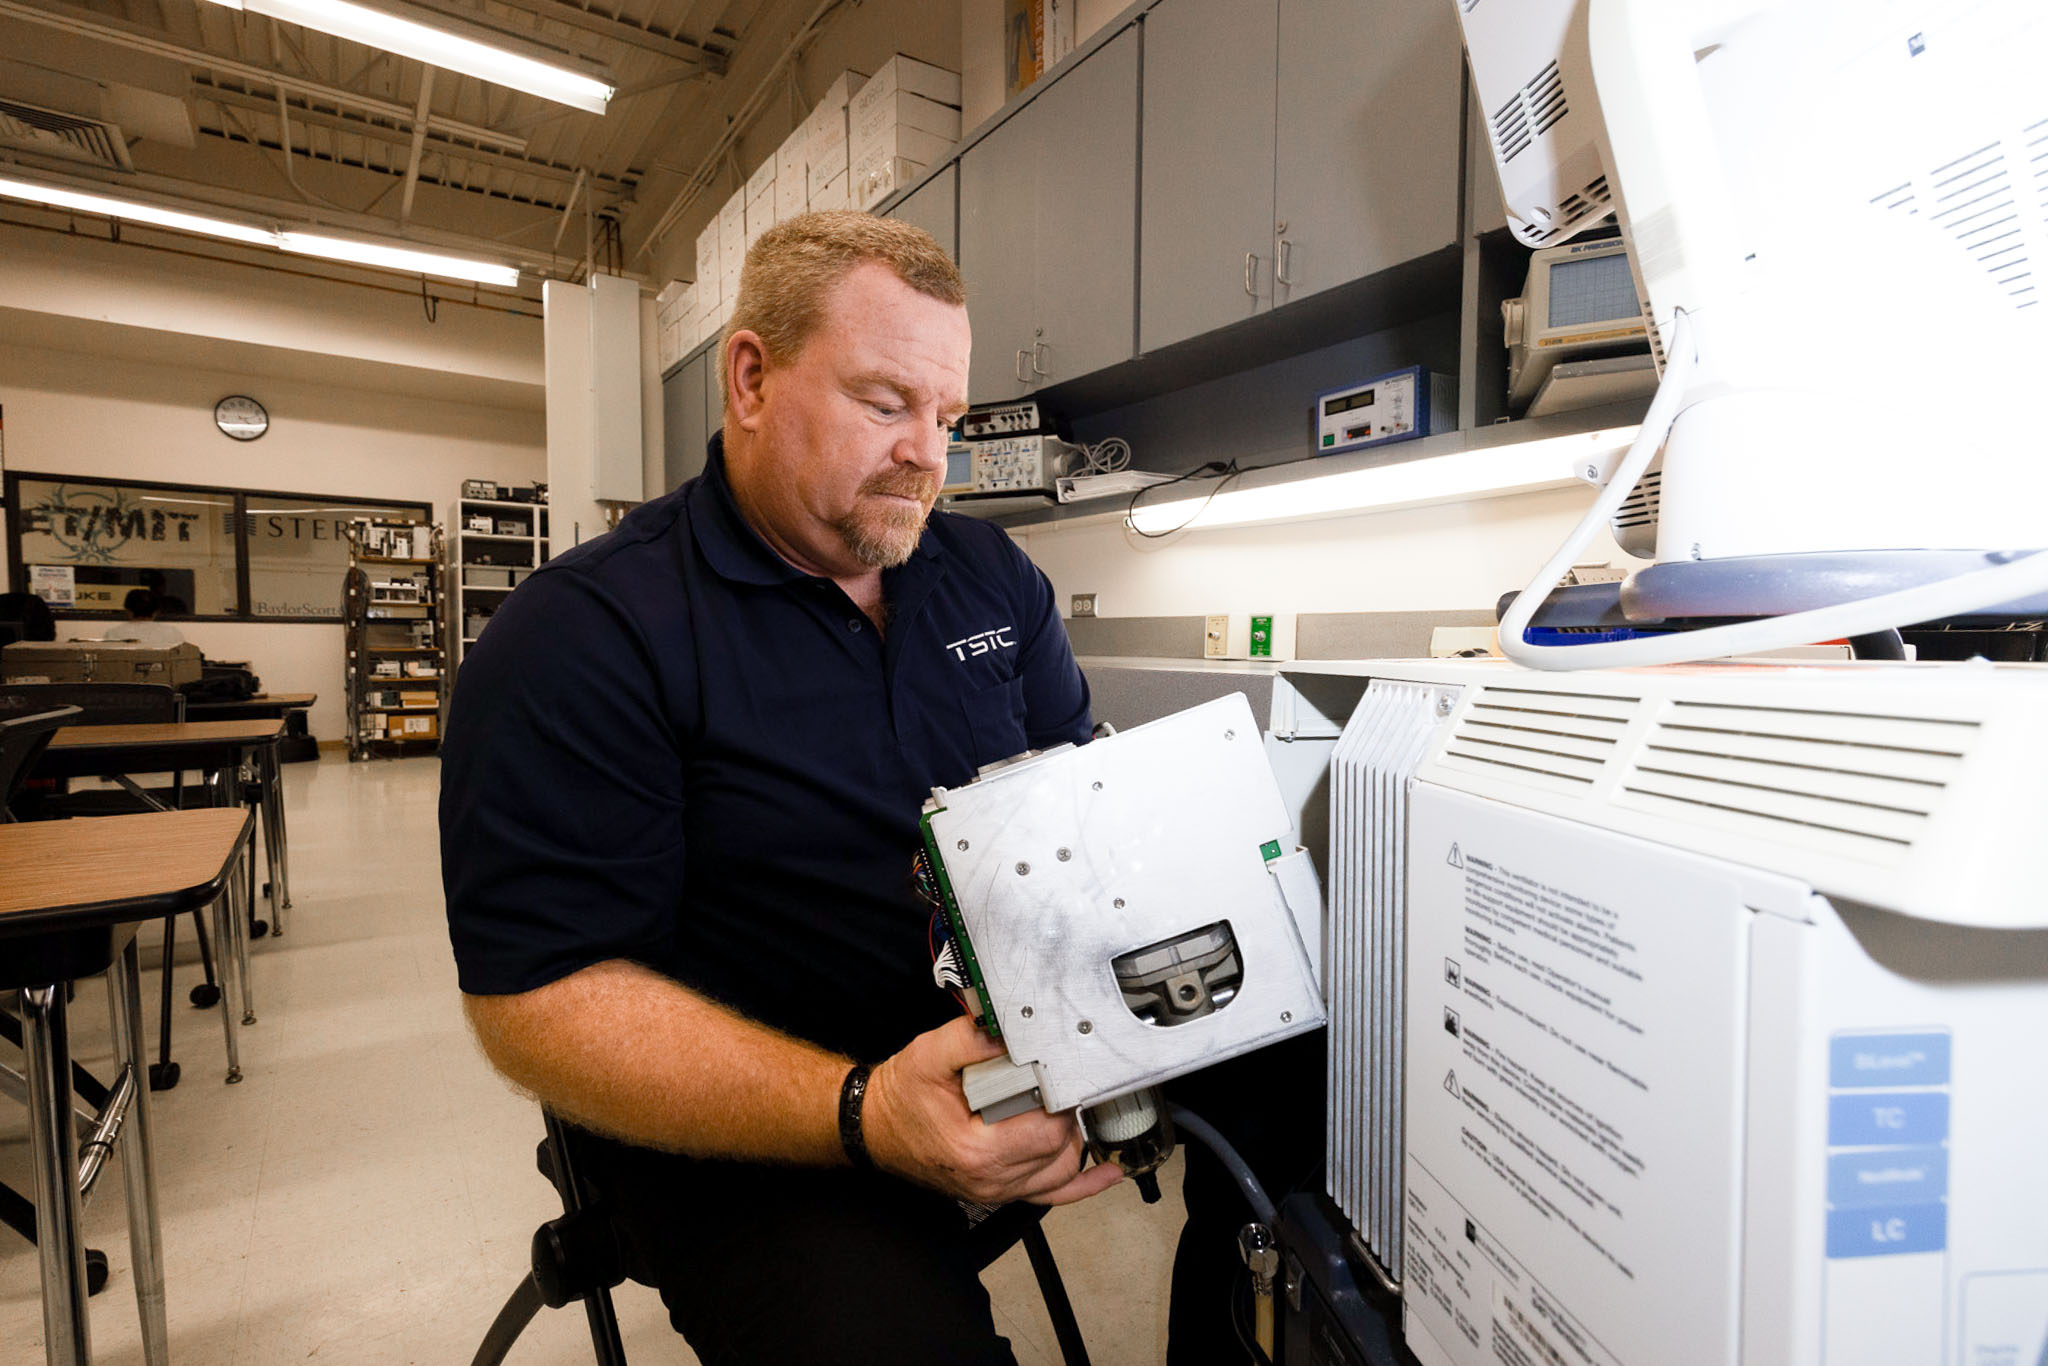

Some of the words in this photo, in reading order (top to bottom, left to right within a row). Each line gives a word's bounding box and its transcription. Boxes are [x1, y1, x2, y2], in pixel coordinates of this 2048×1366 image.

[946, 626, 1012, 661] TSTC
[1872, 1106, 1906, 1129] TC
[1871, 1218, 1906, 1242] LC
